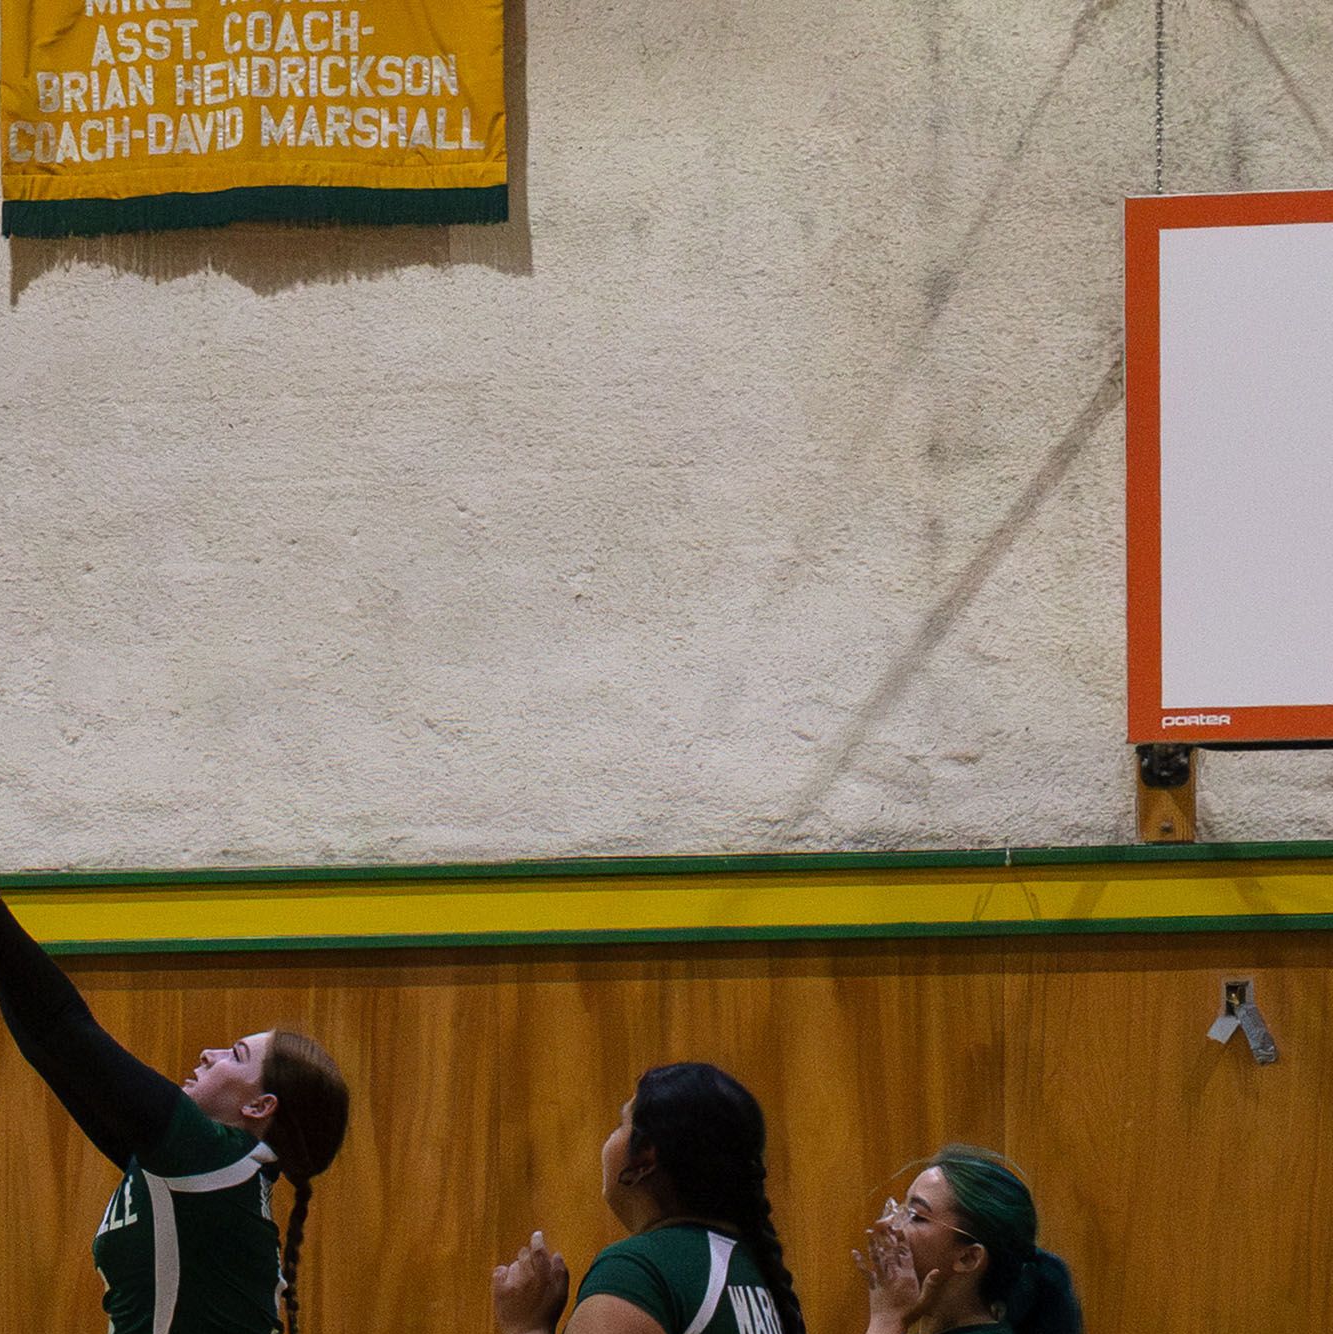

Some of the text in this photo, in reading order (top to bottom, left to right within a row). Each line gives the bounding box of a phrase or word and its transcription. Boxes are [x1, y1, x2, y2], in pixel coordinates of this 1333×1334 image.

[91, 19, 206, 67] ASST.
[37, 54, 458, 113] BRIAN HENDRICKSON
[260, 104, 486, 150] MARSHALL
